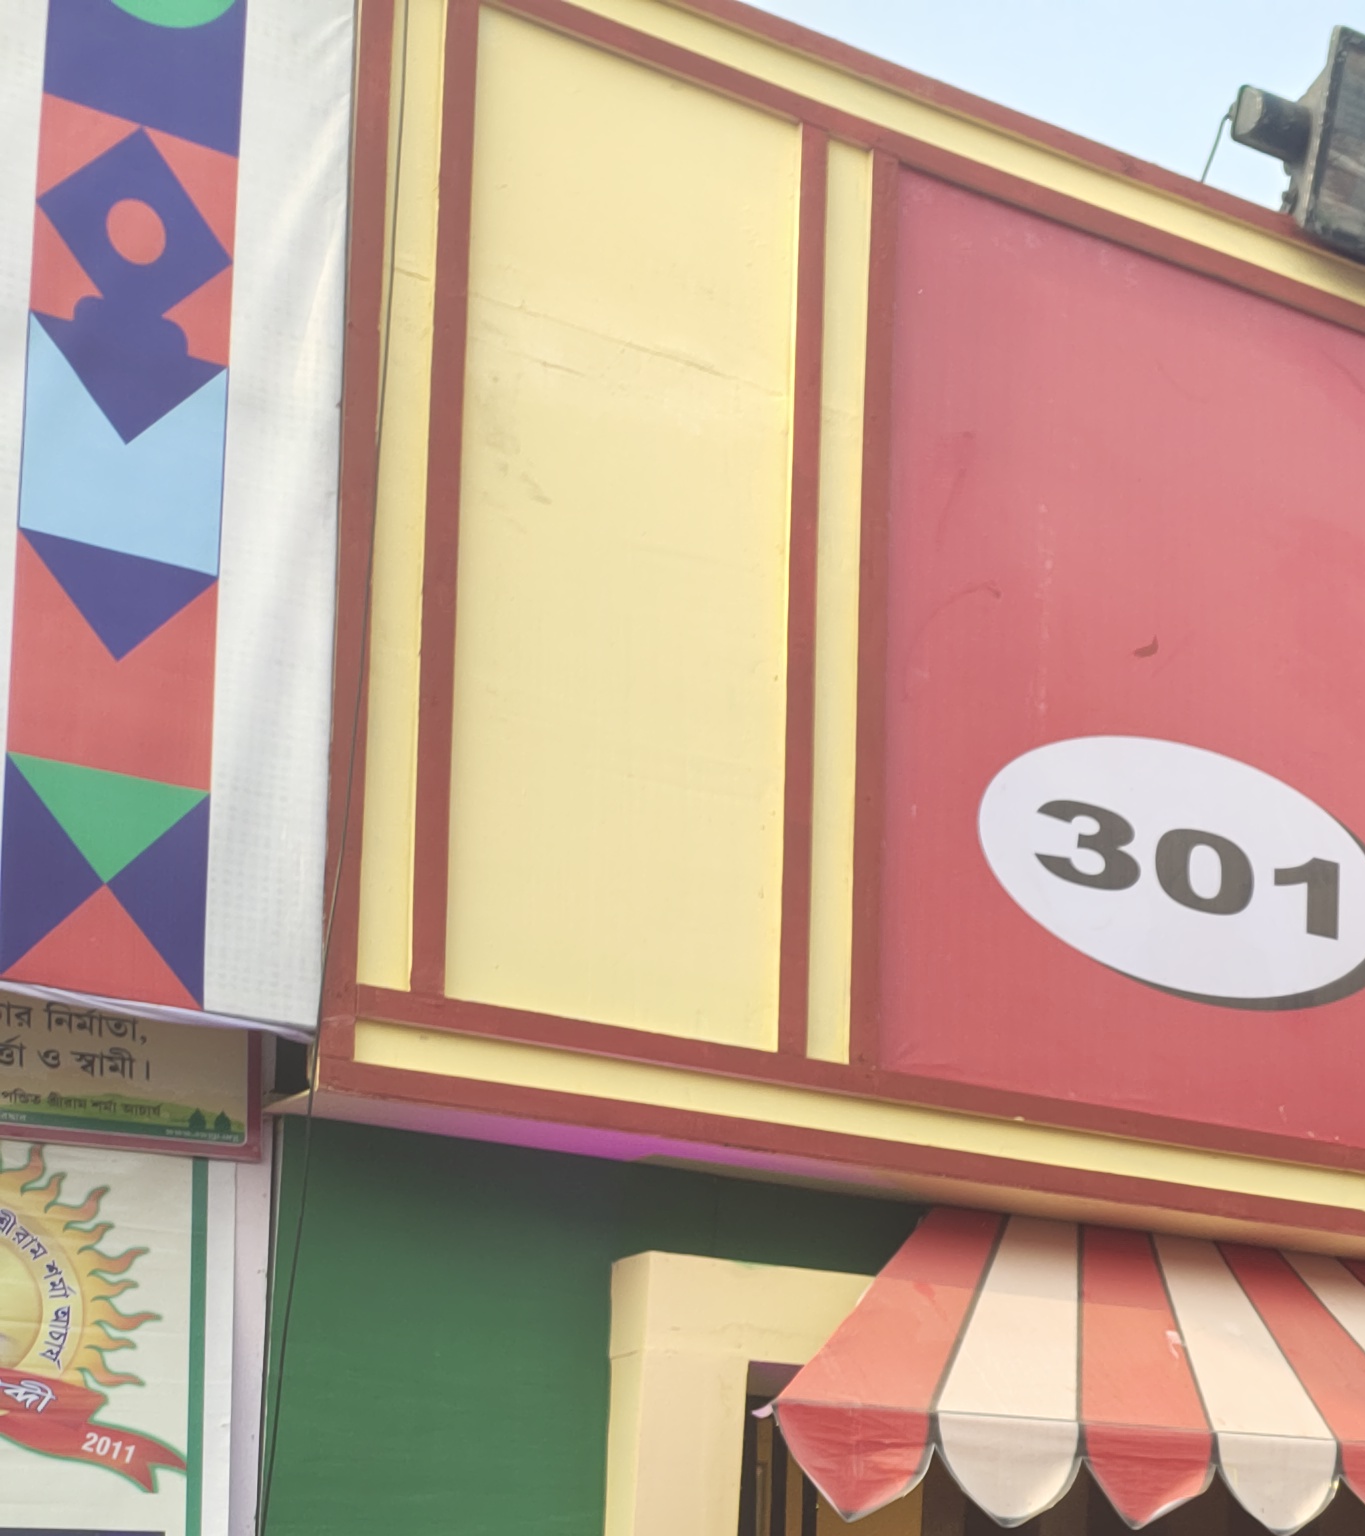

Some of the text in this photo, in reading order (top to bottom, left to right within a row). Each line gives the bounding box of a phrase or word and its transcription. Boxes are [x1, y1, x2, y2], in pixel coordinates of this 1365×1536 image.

[1034, 799, 1340, 940] 301
[37, 1049, 61, 1069] ও
[81, 1432, 136, 1463] 2011
